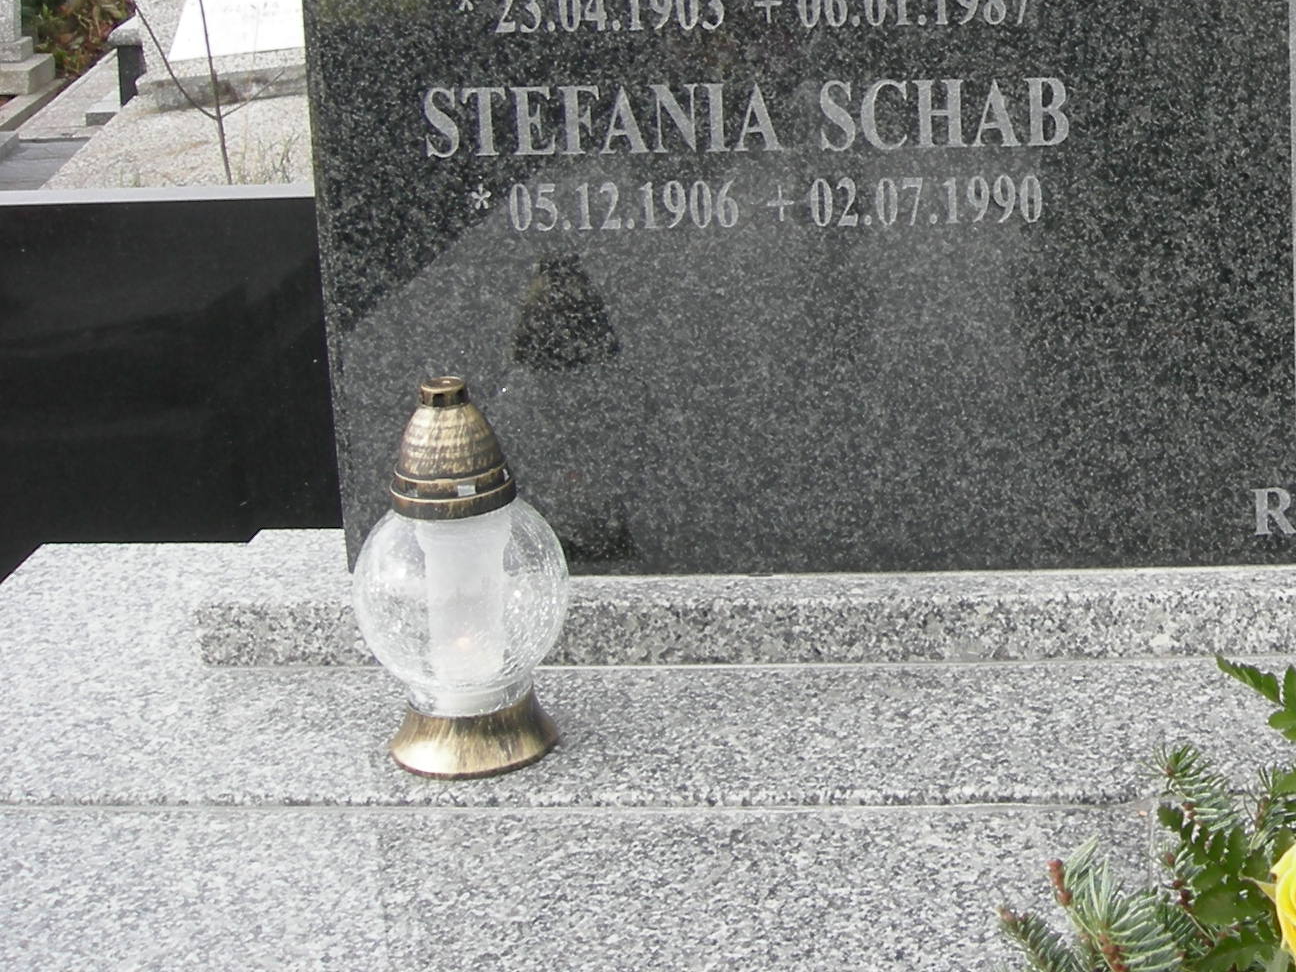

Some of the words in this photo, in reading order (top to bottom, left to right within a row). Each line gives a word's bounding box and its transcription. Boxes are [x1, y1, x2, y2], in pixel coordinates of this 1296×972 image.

[424, 82, 784, 159] STEFANIA
[820, 77, 1070, 152] SCHAB
[509, 180, 740, 231] 05.12.1906
[810, 175, 1043, 228] 02.07.1990
